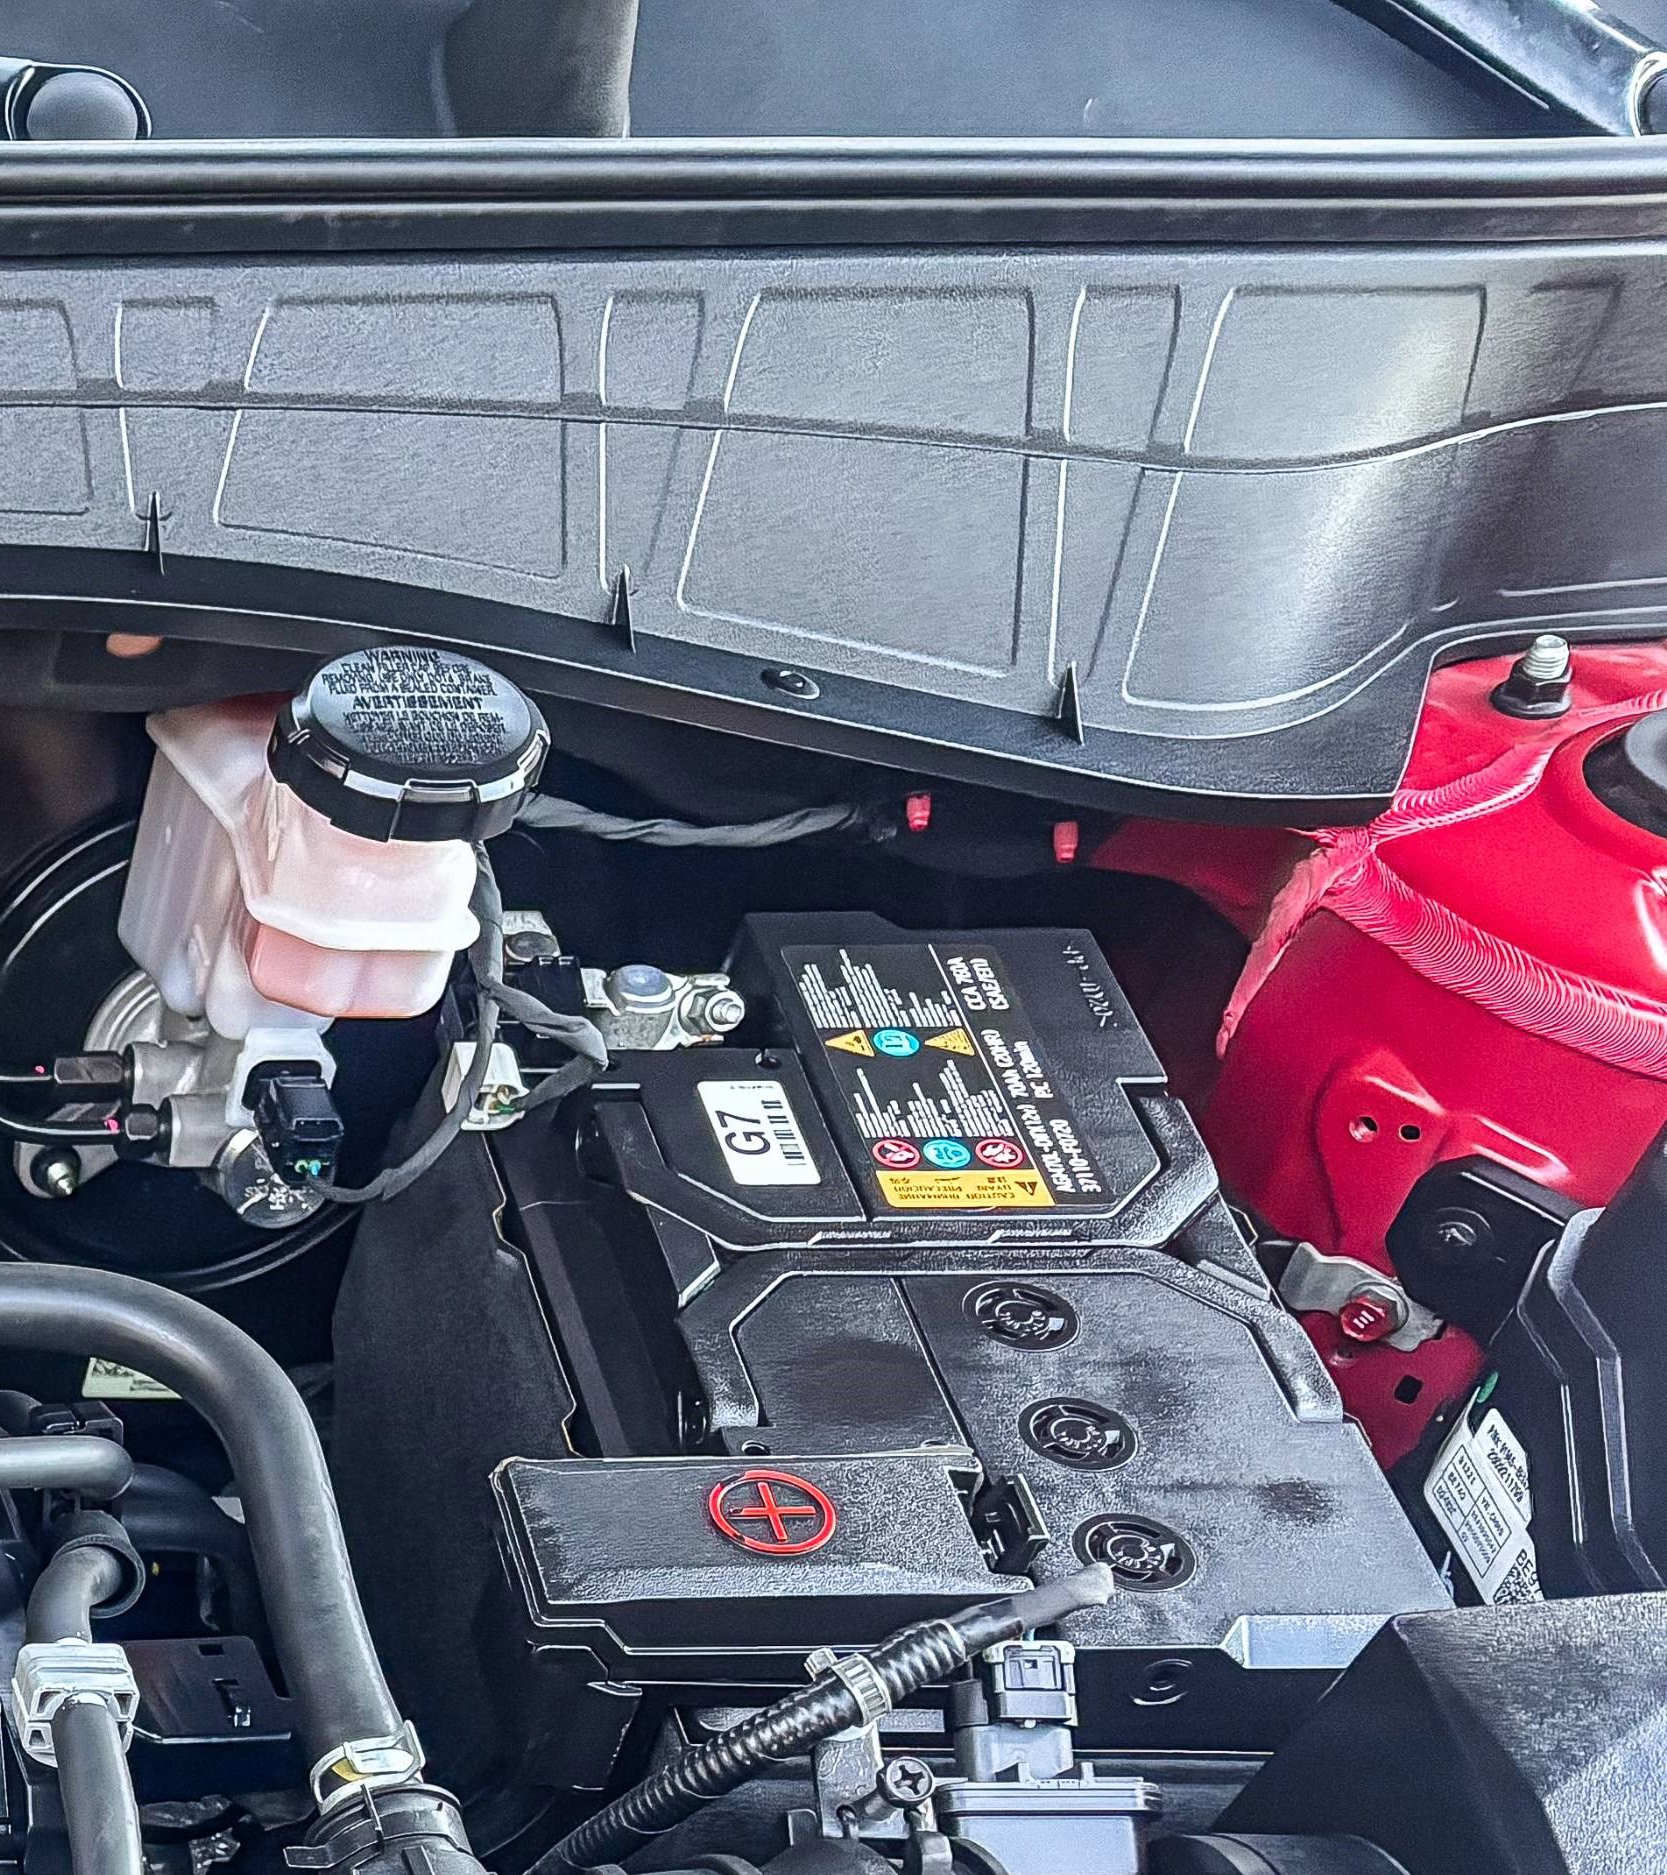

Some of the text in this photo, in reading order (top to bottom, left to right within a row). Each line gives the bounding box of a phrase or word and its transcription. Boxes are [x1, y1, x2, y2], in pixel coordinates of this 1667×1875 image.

[365, 650, 441, 664] WARNING
[961, 986, 986, 1011] CCA
[715, 1110, 771, 1155] G7
